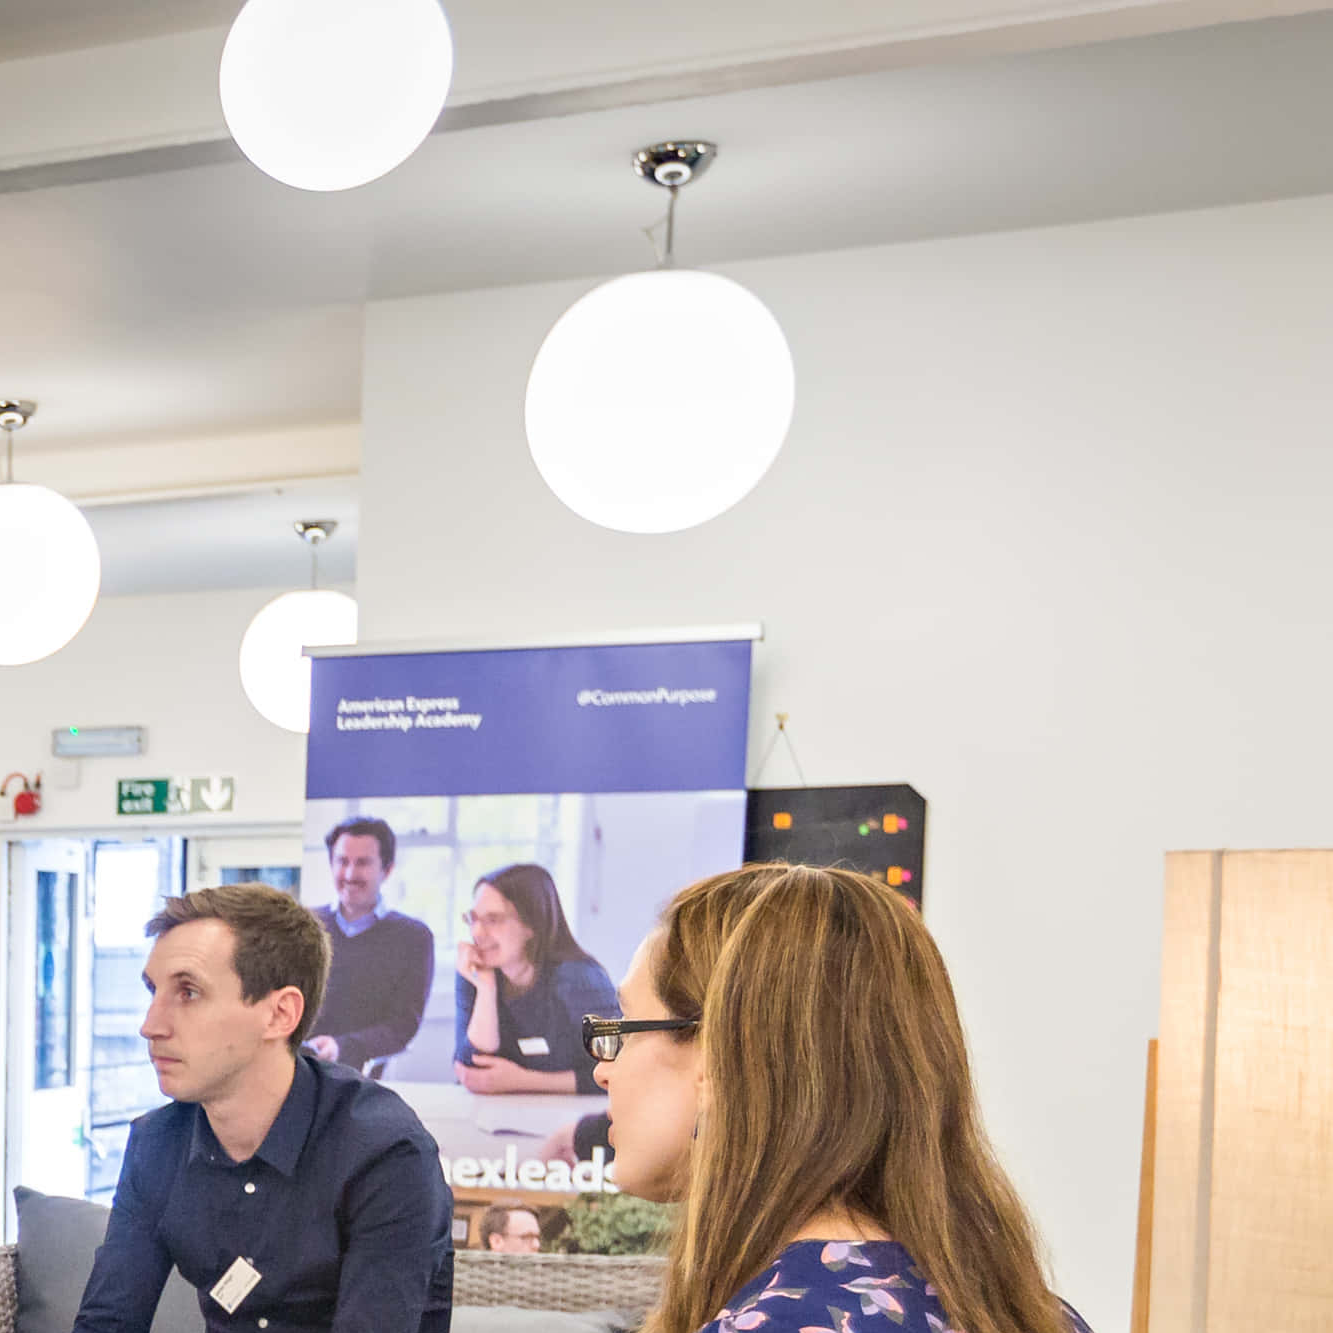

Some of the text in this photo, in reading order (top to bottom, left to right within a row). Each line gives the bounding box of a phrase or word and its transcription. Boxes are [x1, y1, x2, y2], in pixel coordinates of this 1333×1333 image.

[338, 696, 459, 714] American Express
[337, 711, 482, 733] Leadership Academy
[120, 782, 155, 797] Fire
[121, 798, 152, 813] exit
